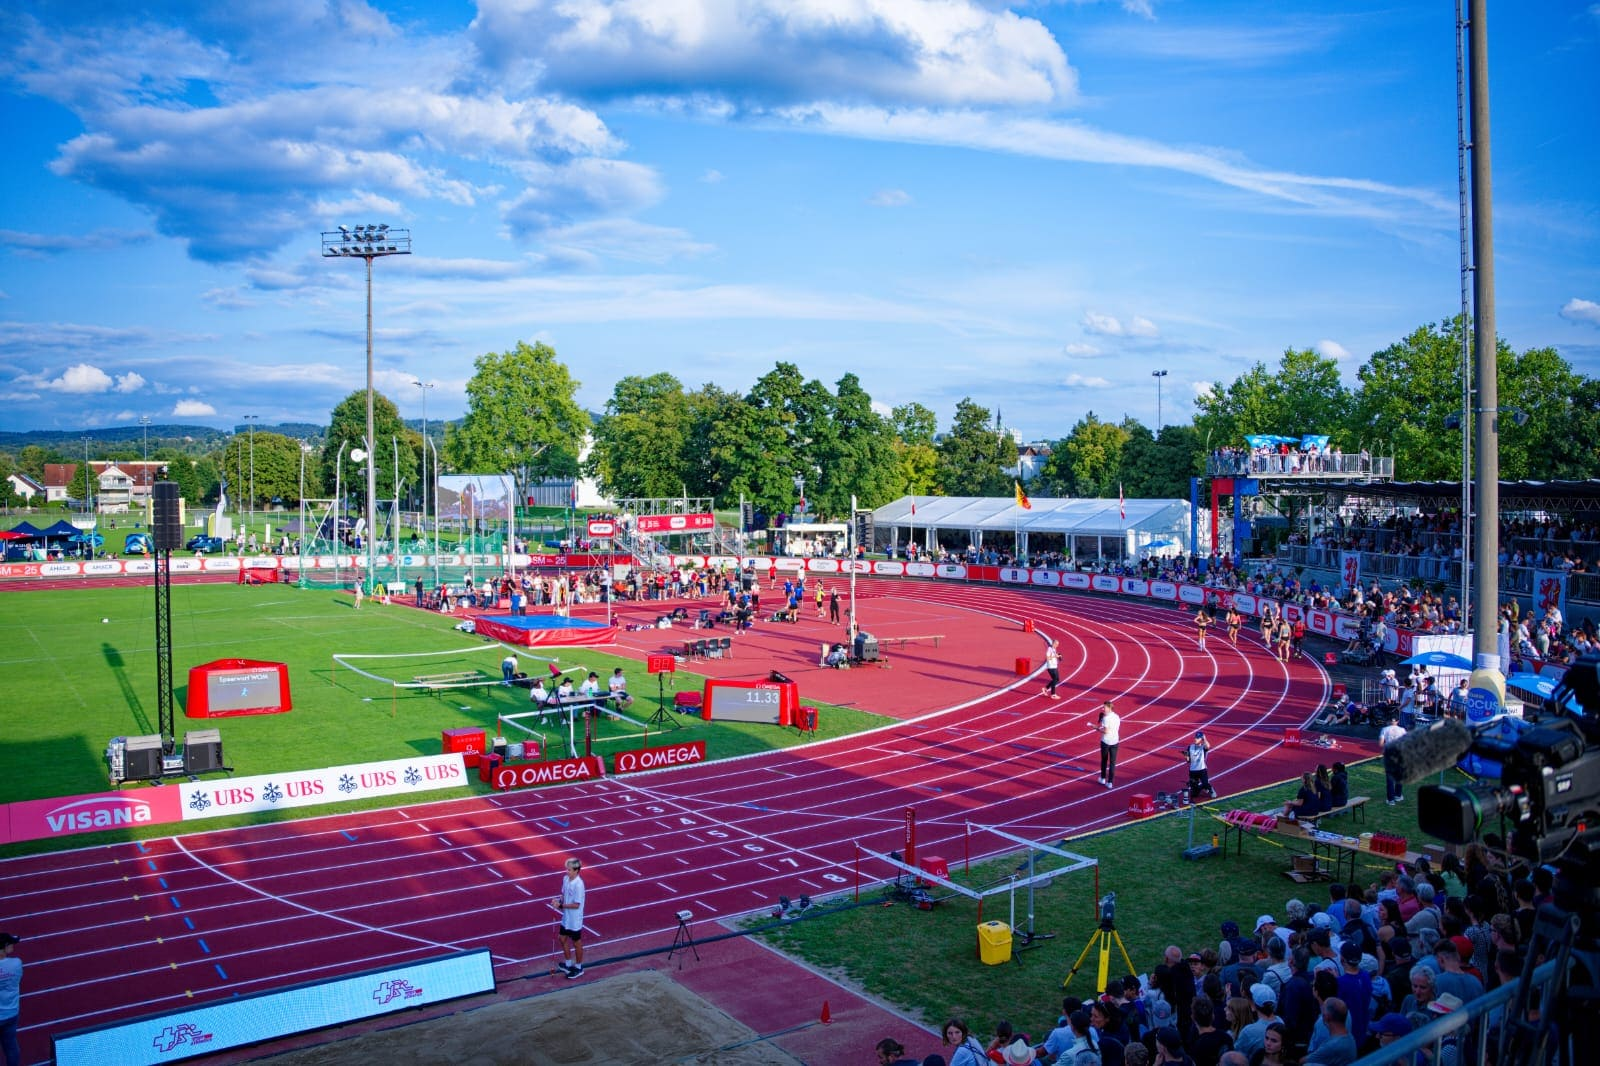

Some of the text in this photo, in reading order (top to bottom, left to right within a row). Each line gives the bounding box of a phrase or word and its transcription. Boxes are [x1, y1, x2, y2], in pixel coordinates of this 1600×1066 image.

[746, 691, 779, 704] 11.33
[640, 745, 701, 768] OMEGA
[424, 763, 460, 781] UBS
[521, 761, 590, 783] OMEGA
[361, 770, 397, 789] UBS
[286, 779, 325, 799] UBS
[214, 787, 255, 806] UBS
[618, 794, 638, 802] 2
[680, 817, 696, 825] 4
[706, 830, 729, 838] 5
[743, 843, 765, 852] 6
[779, 857, 799, 867] 7
[822, 873, 848, 883] 8
